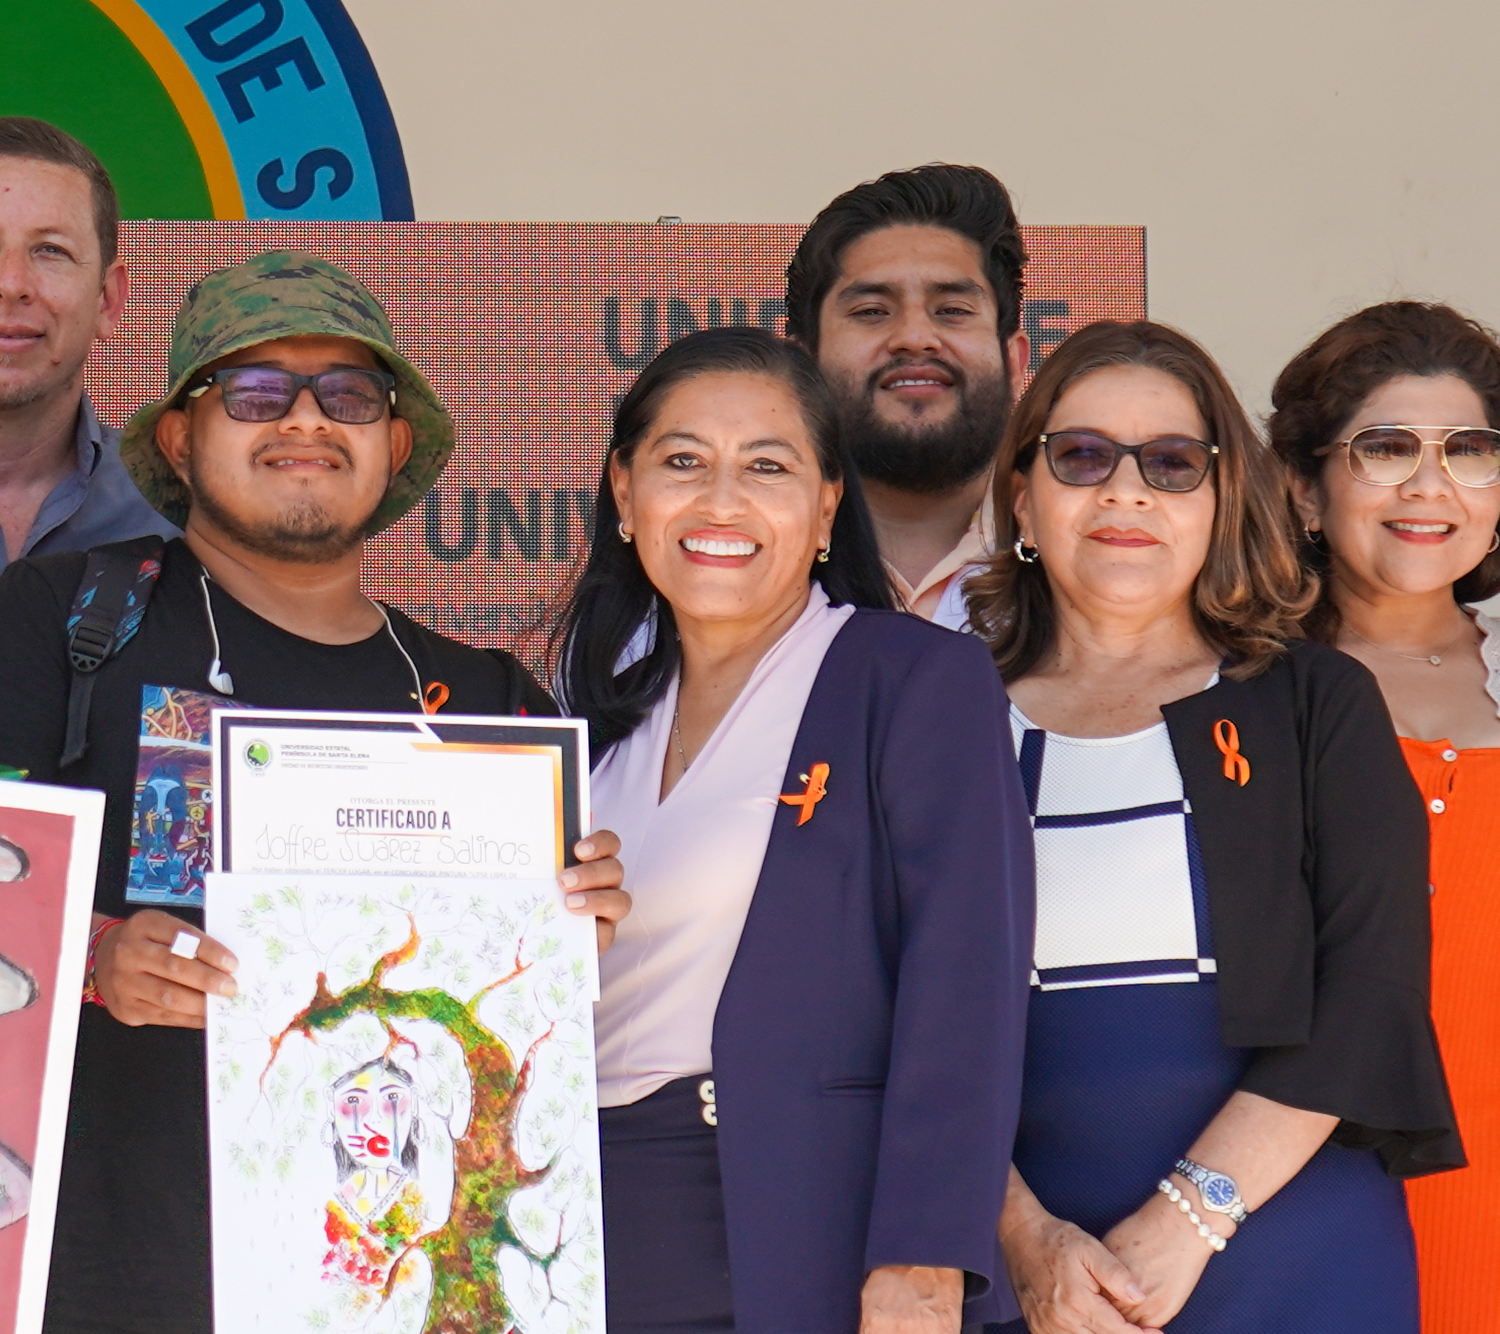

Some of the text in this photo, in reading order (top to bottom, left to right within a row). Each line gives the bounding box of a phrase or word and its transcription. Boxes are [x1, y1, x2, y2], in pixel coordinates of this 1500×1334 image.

[397, 798, 436, 806] PRESENTE
[336, 807, 452, 830] CERTIFICADO A
